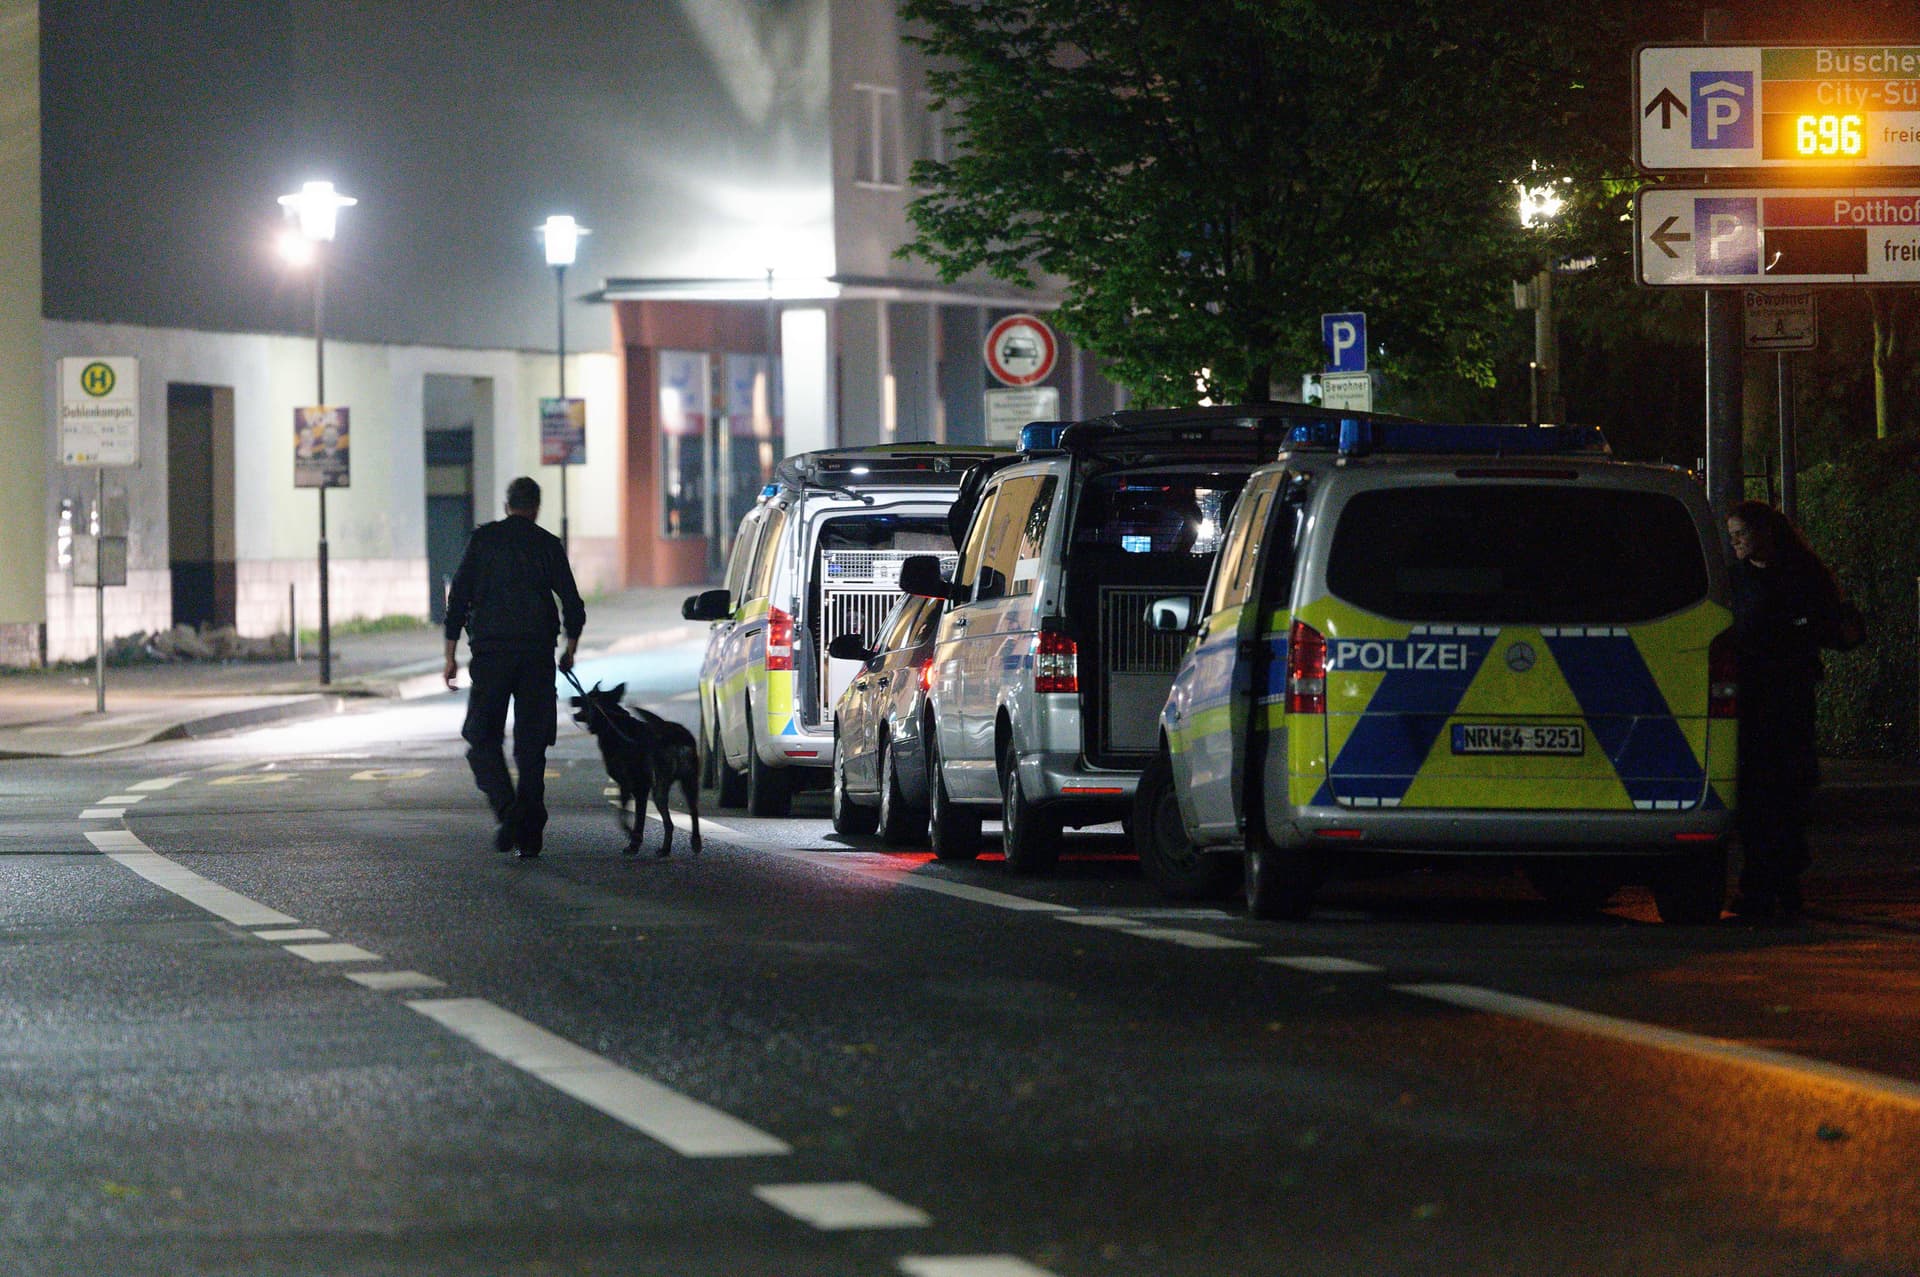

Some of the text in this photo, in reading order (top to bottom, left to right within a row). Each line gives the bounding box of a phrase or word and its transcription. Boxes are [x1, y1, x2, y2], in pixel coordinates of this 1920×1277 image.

[1707, 97, 1741, 141] P
[1797, 114, 1862, 154] 696
[1710, 213, 1743, 260] P
[1333, 321, 1356, 366] P
[89, 371, 106, 388] H
[1336, 641, 1467, 671] POLIZEI
